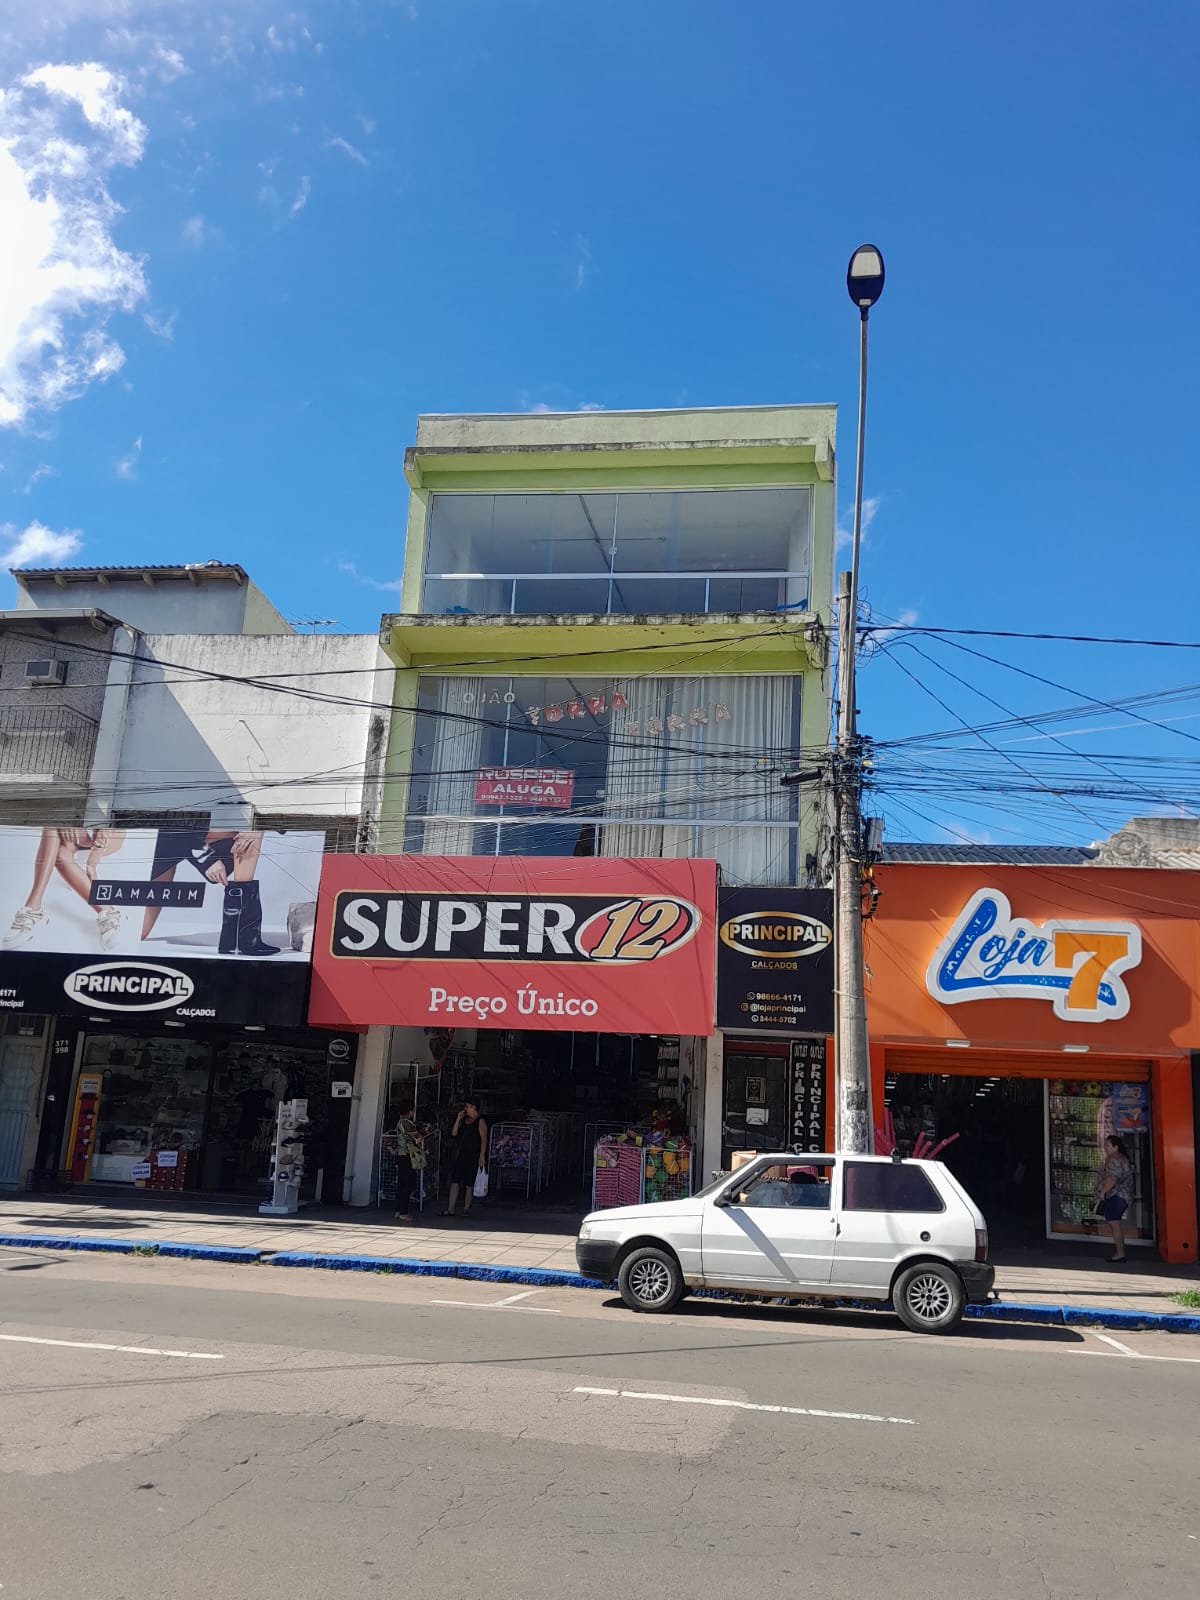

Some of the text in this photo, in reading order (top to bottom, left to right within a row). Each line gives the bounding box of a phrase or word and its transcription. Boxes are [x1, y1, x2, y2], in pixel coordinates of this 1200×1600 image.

[493, 783, 557, 797] ALUGA
[96, 885, 198, 901] RAMARIM
[340, 898, 680, 959] SUPER 12
[729, 923, 828, 942] PRINCIPAL
[939, 897, 1128, 1010] Loja 7
[751, 960, 798, 969] CALÇADOS
[74, 974, 189, 995] PRINCIPAL
[428, 982, 599, 1020] Preço Único
[750, 1003, 807, 1014] @lojaprincipal
[175, 1007, 216, 1017] CALÇADOS
[809, 1063, 822, 1138] PRINCIPAL
